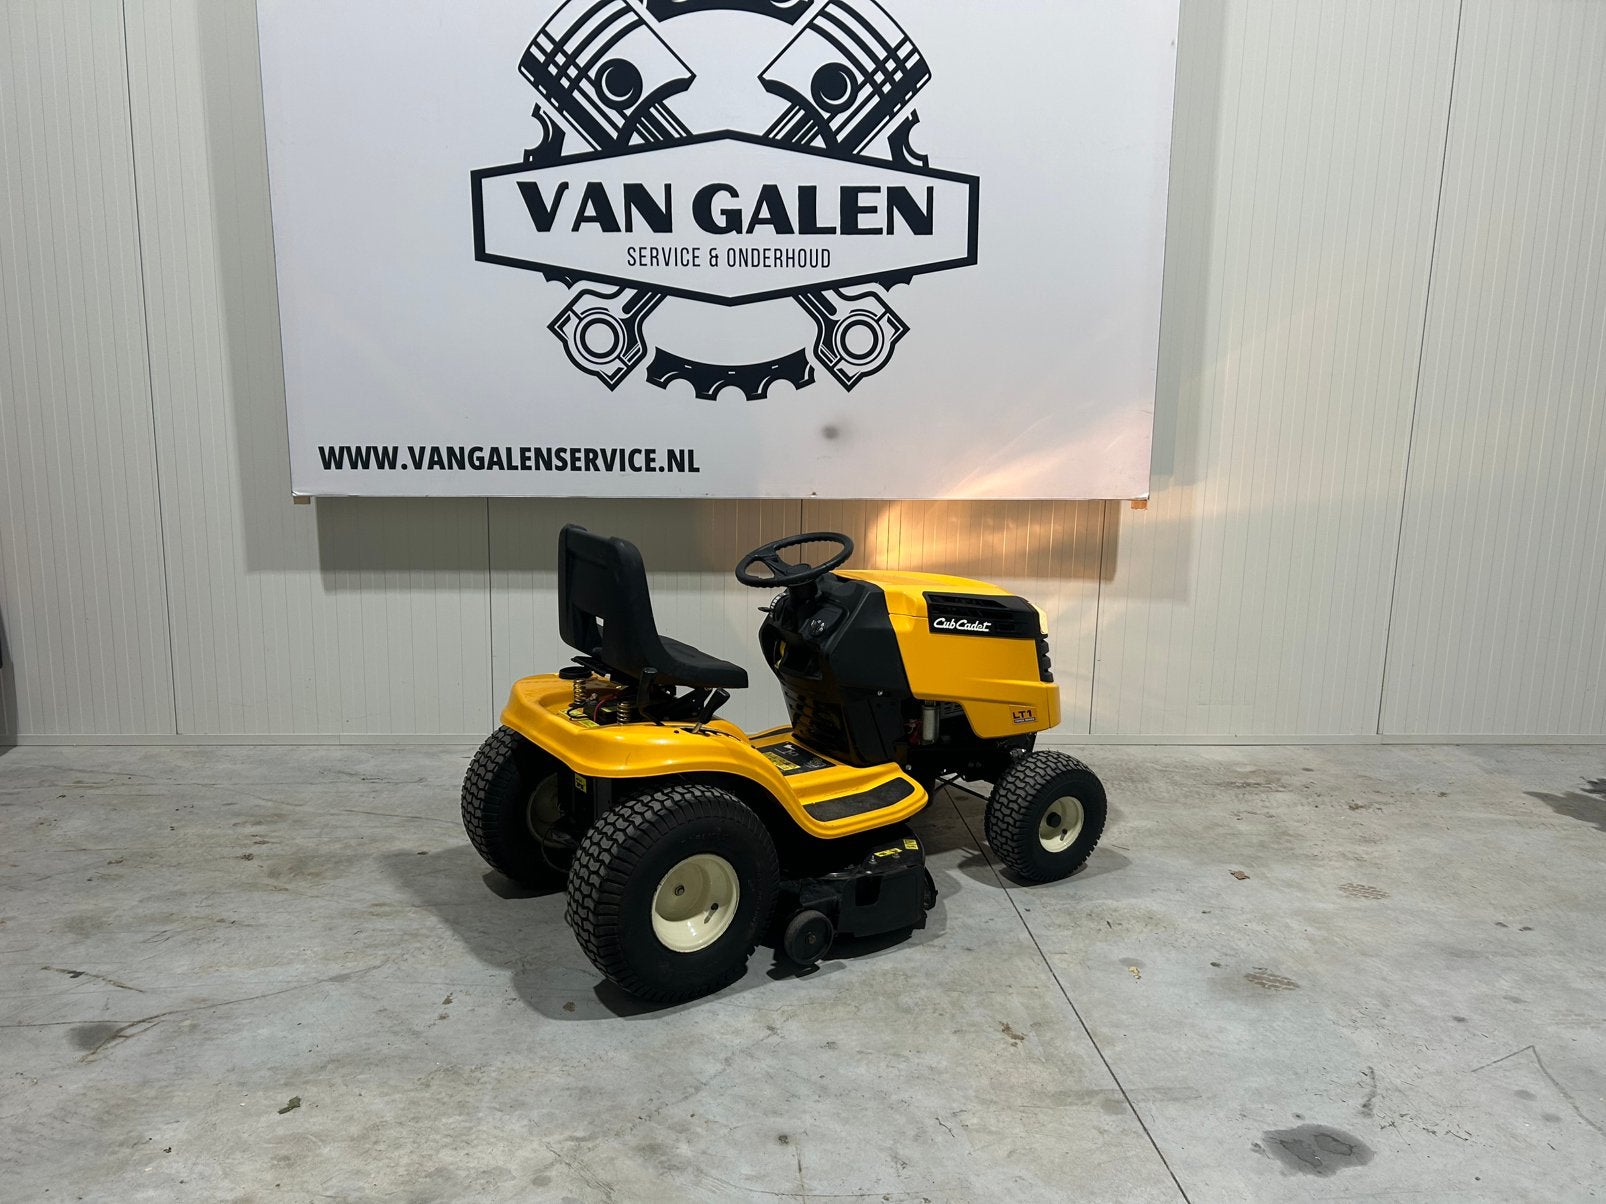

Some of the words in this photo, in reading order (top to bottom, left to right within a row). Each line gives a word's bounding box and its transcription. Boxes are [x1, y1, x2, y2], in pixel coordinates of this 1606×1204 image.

[516, 181, 673, 234] VAN
[691, 182, 934, 236] GALEN
[627, 246, 701, 268] SERVICE
[708, 247, 719, 268] &
[726, 247, 831, 269] ONDERHOUD
[317, 445, 701, 473] WWW.VANGALENSERVICE.NL
[933, 617, 956, 630] Cub
[956, 619, 992, 632] Cadet
[1012, 709, 1033, 719] LT1
